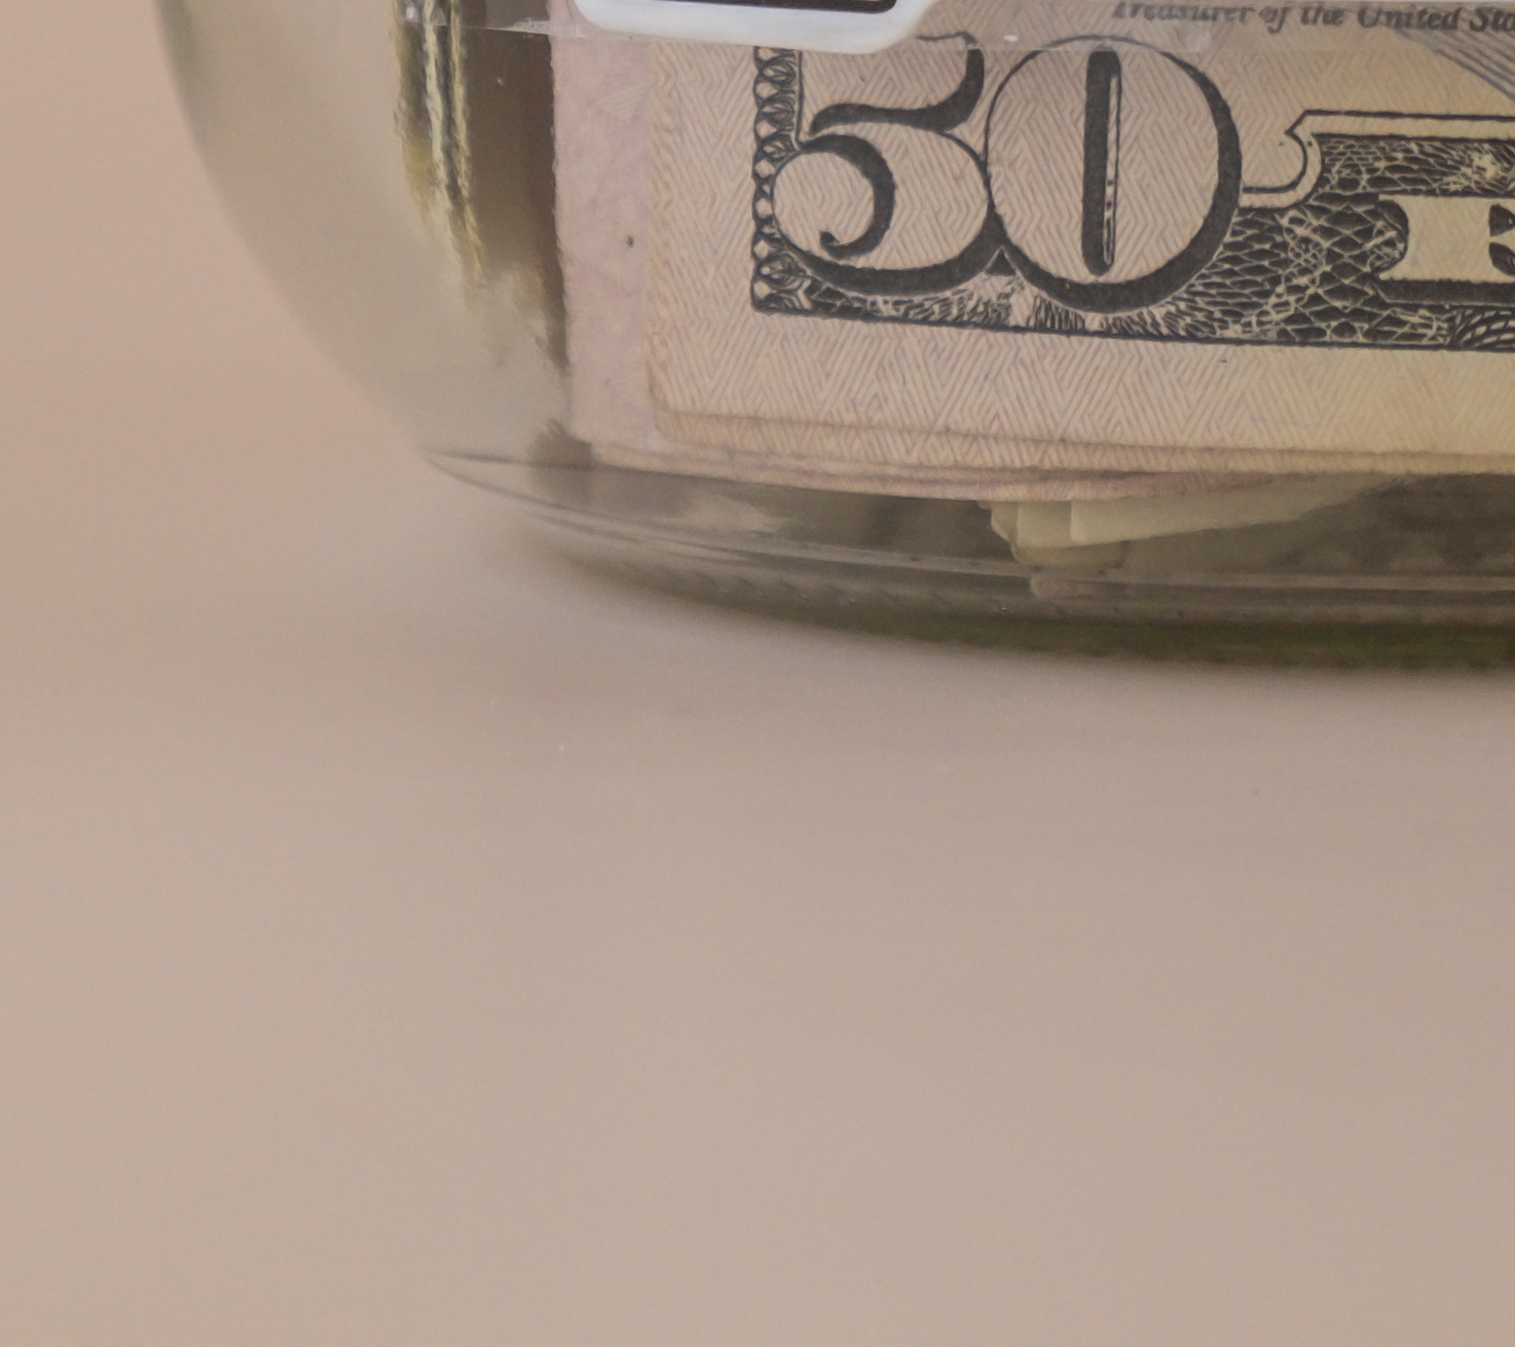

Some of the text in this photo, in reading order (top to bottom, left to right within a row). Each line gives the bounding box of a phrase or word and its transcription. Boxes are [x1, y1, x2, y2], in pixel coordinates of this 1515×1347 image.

[1260, 3, 1287, 34] of
[1299, 4, 1345, 26] the
[1357, 3, 1461, 31] United
[770, 31, 1242, 314] 50
